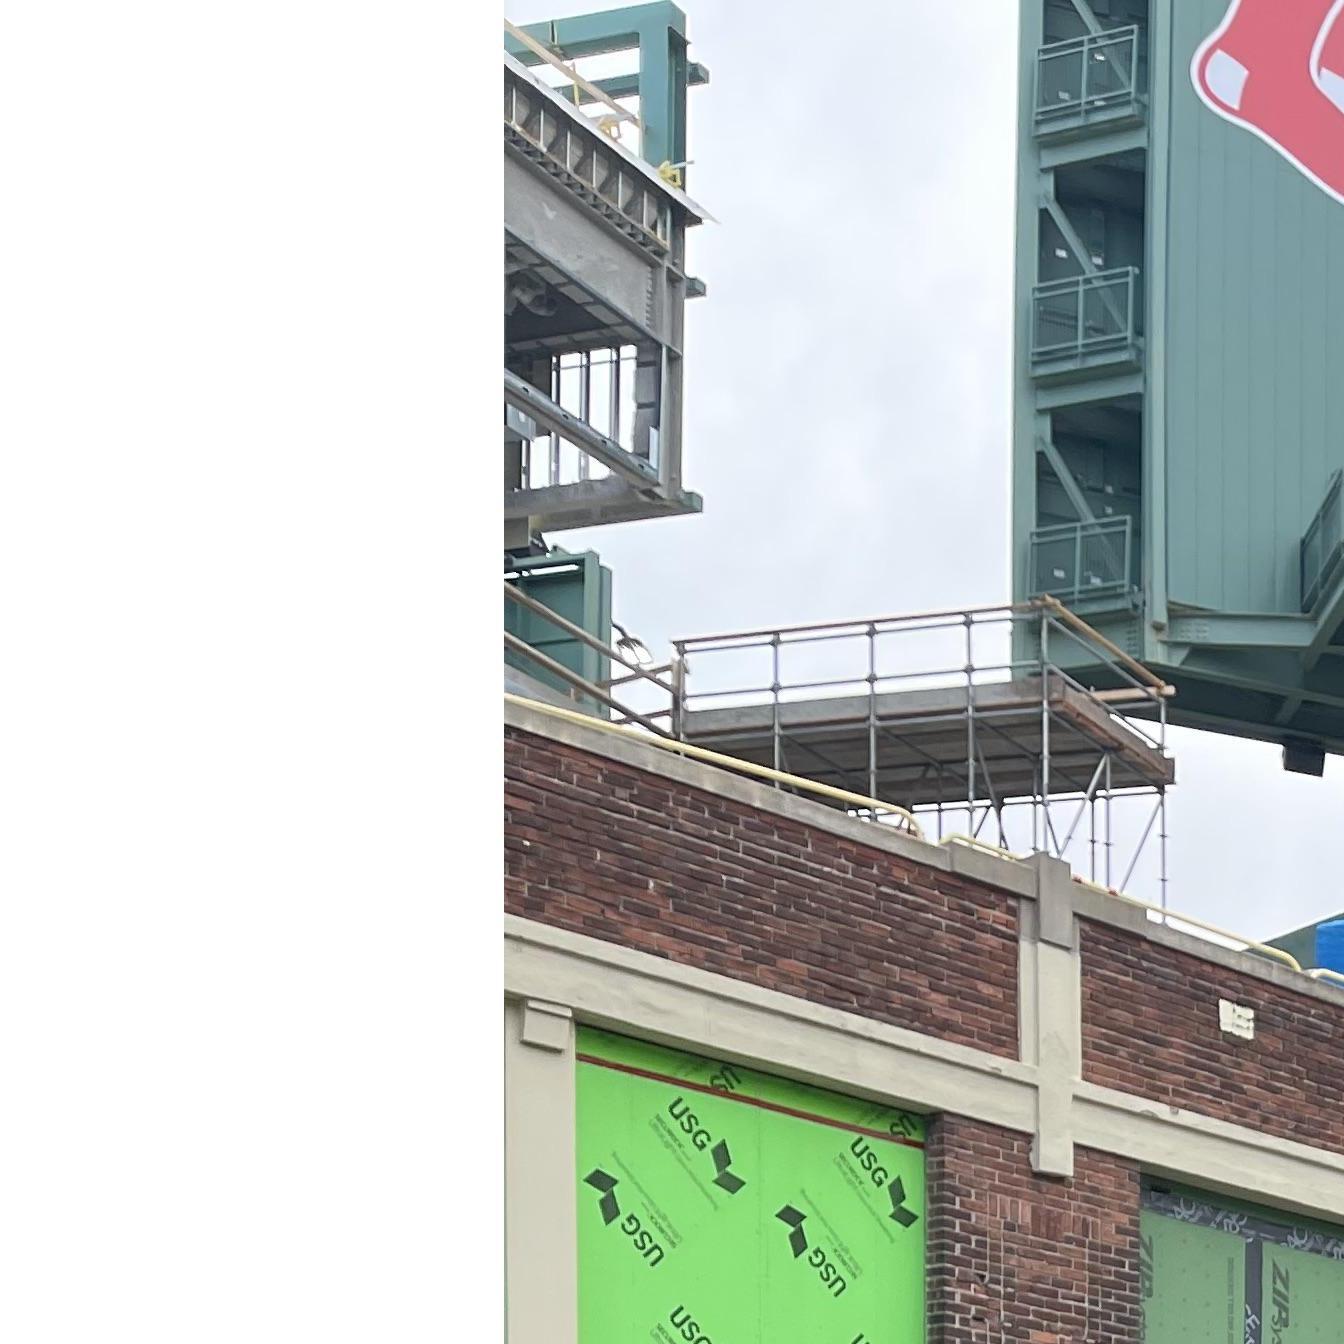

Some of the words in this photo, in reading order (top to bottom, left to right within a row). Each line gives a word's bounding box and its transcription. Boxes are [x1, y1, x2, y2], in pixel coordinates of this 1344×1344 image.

[668, 1096, 712, 1152] USG
[851, 1136, 888, 1188] USG
[621, 1213, 665, 1267] USG
[808, 1247, 847, 1298] USG
